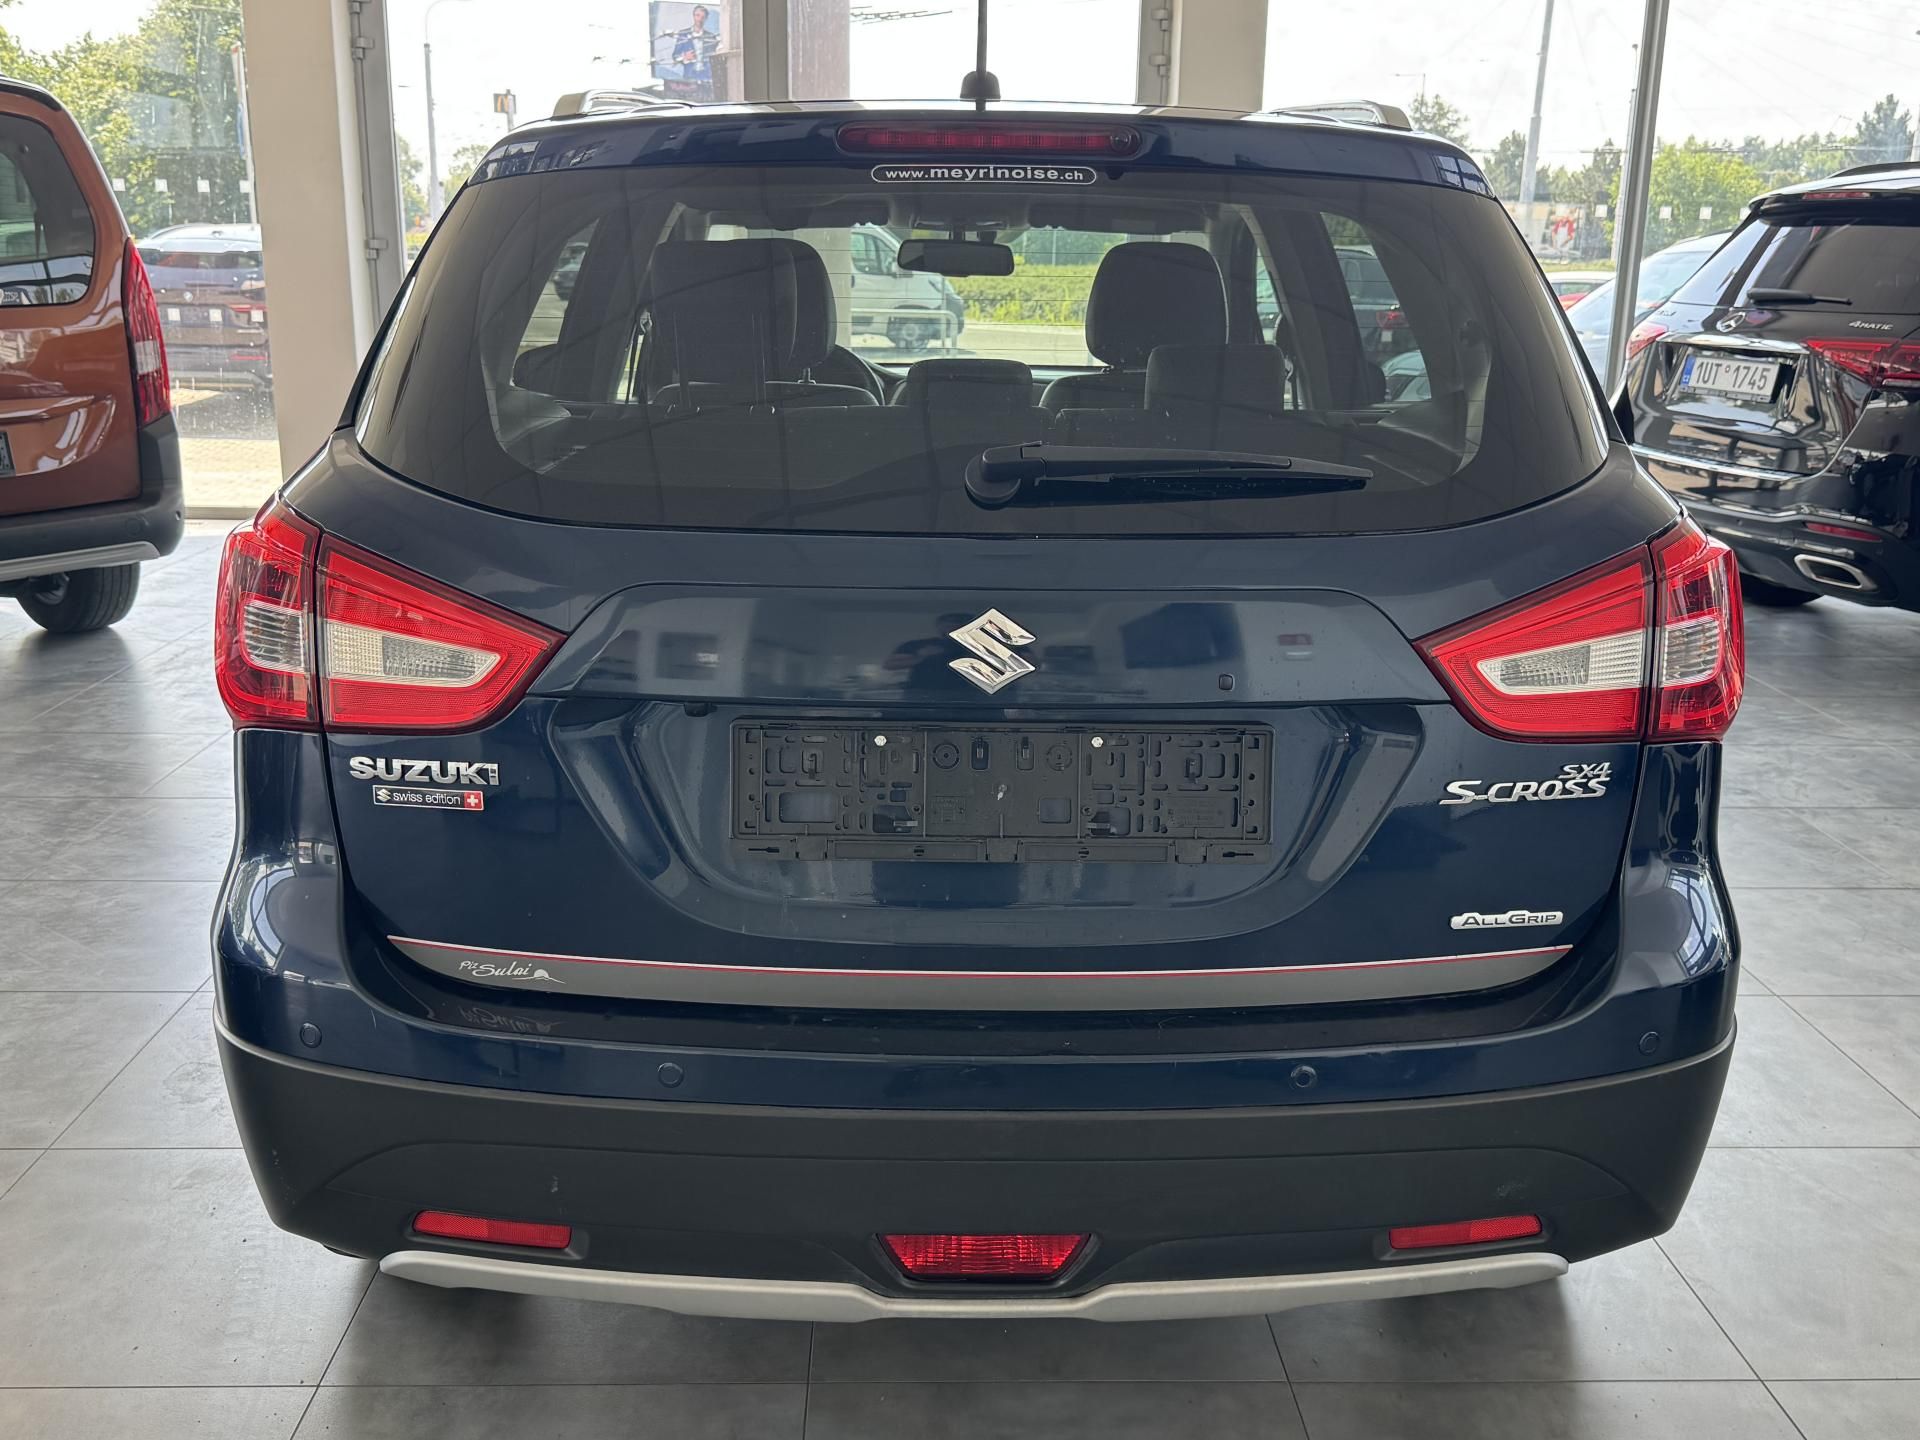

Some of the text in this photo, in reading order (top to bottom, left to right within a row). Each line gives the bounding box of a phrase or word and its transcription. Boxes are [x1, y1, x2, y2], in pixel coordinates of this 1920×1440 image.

[885, 166, 1084, 181] www.meyrinoise.ch
[1696, 361, 1771, 391] 1UT 1745
[350, 756, 500, 785] SUZUKI
[1558, 762, 1612, 779] SX4
[393, 790, 461, 805] swiss edition
[1439, 777, 1611, 805] S-CROSS
[459, 960, 532, 977] Piz Sulai
